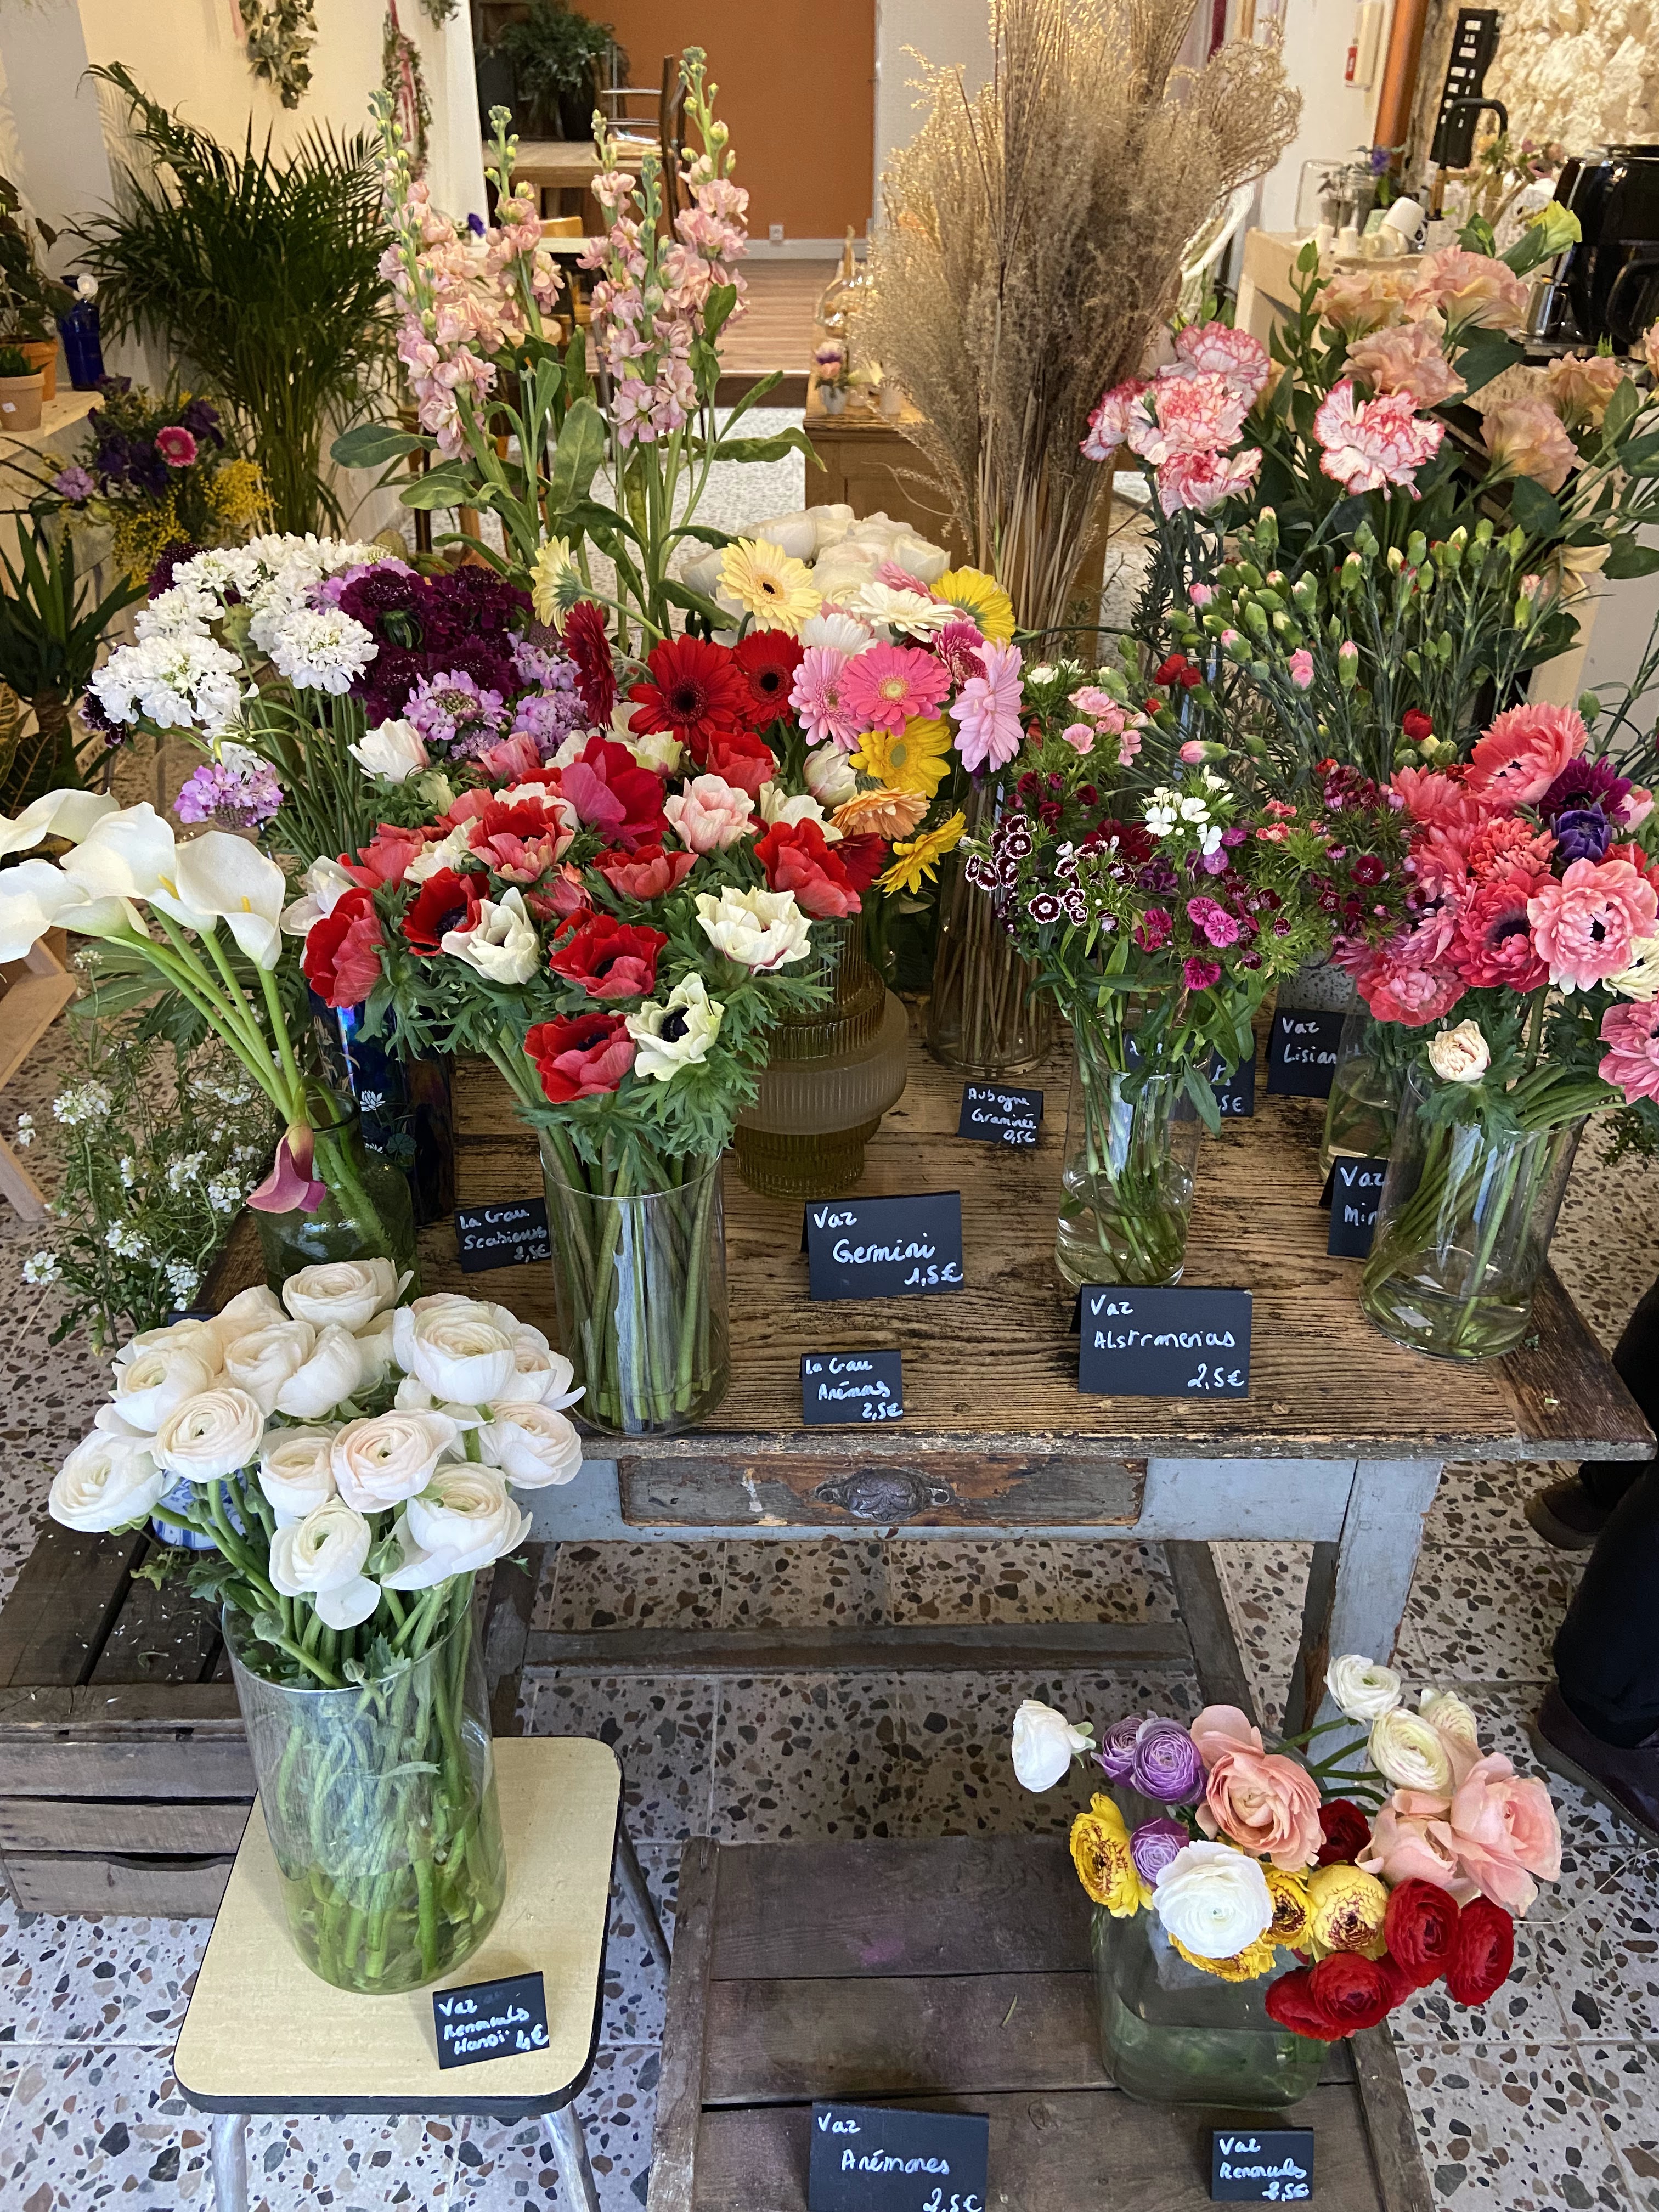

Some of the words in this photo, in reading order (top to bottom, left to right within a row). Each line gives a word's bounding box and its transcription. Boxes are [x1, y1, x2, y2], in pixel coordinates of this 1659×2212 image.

[1282, 1017, 1319, 1034] Vaz
[1340, 1165, 1386, 1187] Vaz
[484, 1209, 530, 1223] Crau
[813, 1206, 857, 1228] Vaz
[1091, 1294, 1133, 1316] Vaz
[829, 1357, 873, 1374] Crau
[1187, 1363, 1245, 1390] 2,5€
[862, 1402, 904, 1421] 2,5€
[438, 1996, 478, 2016] Vaz
[817, 2112, 861, 2134] Vaz
[1219, 2136, 1261, 2155] Vaz
[841, 2148, 950, 2175] Anémones
